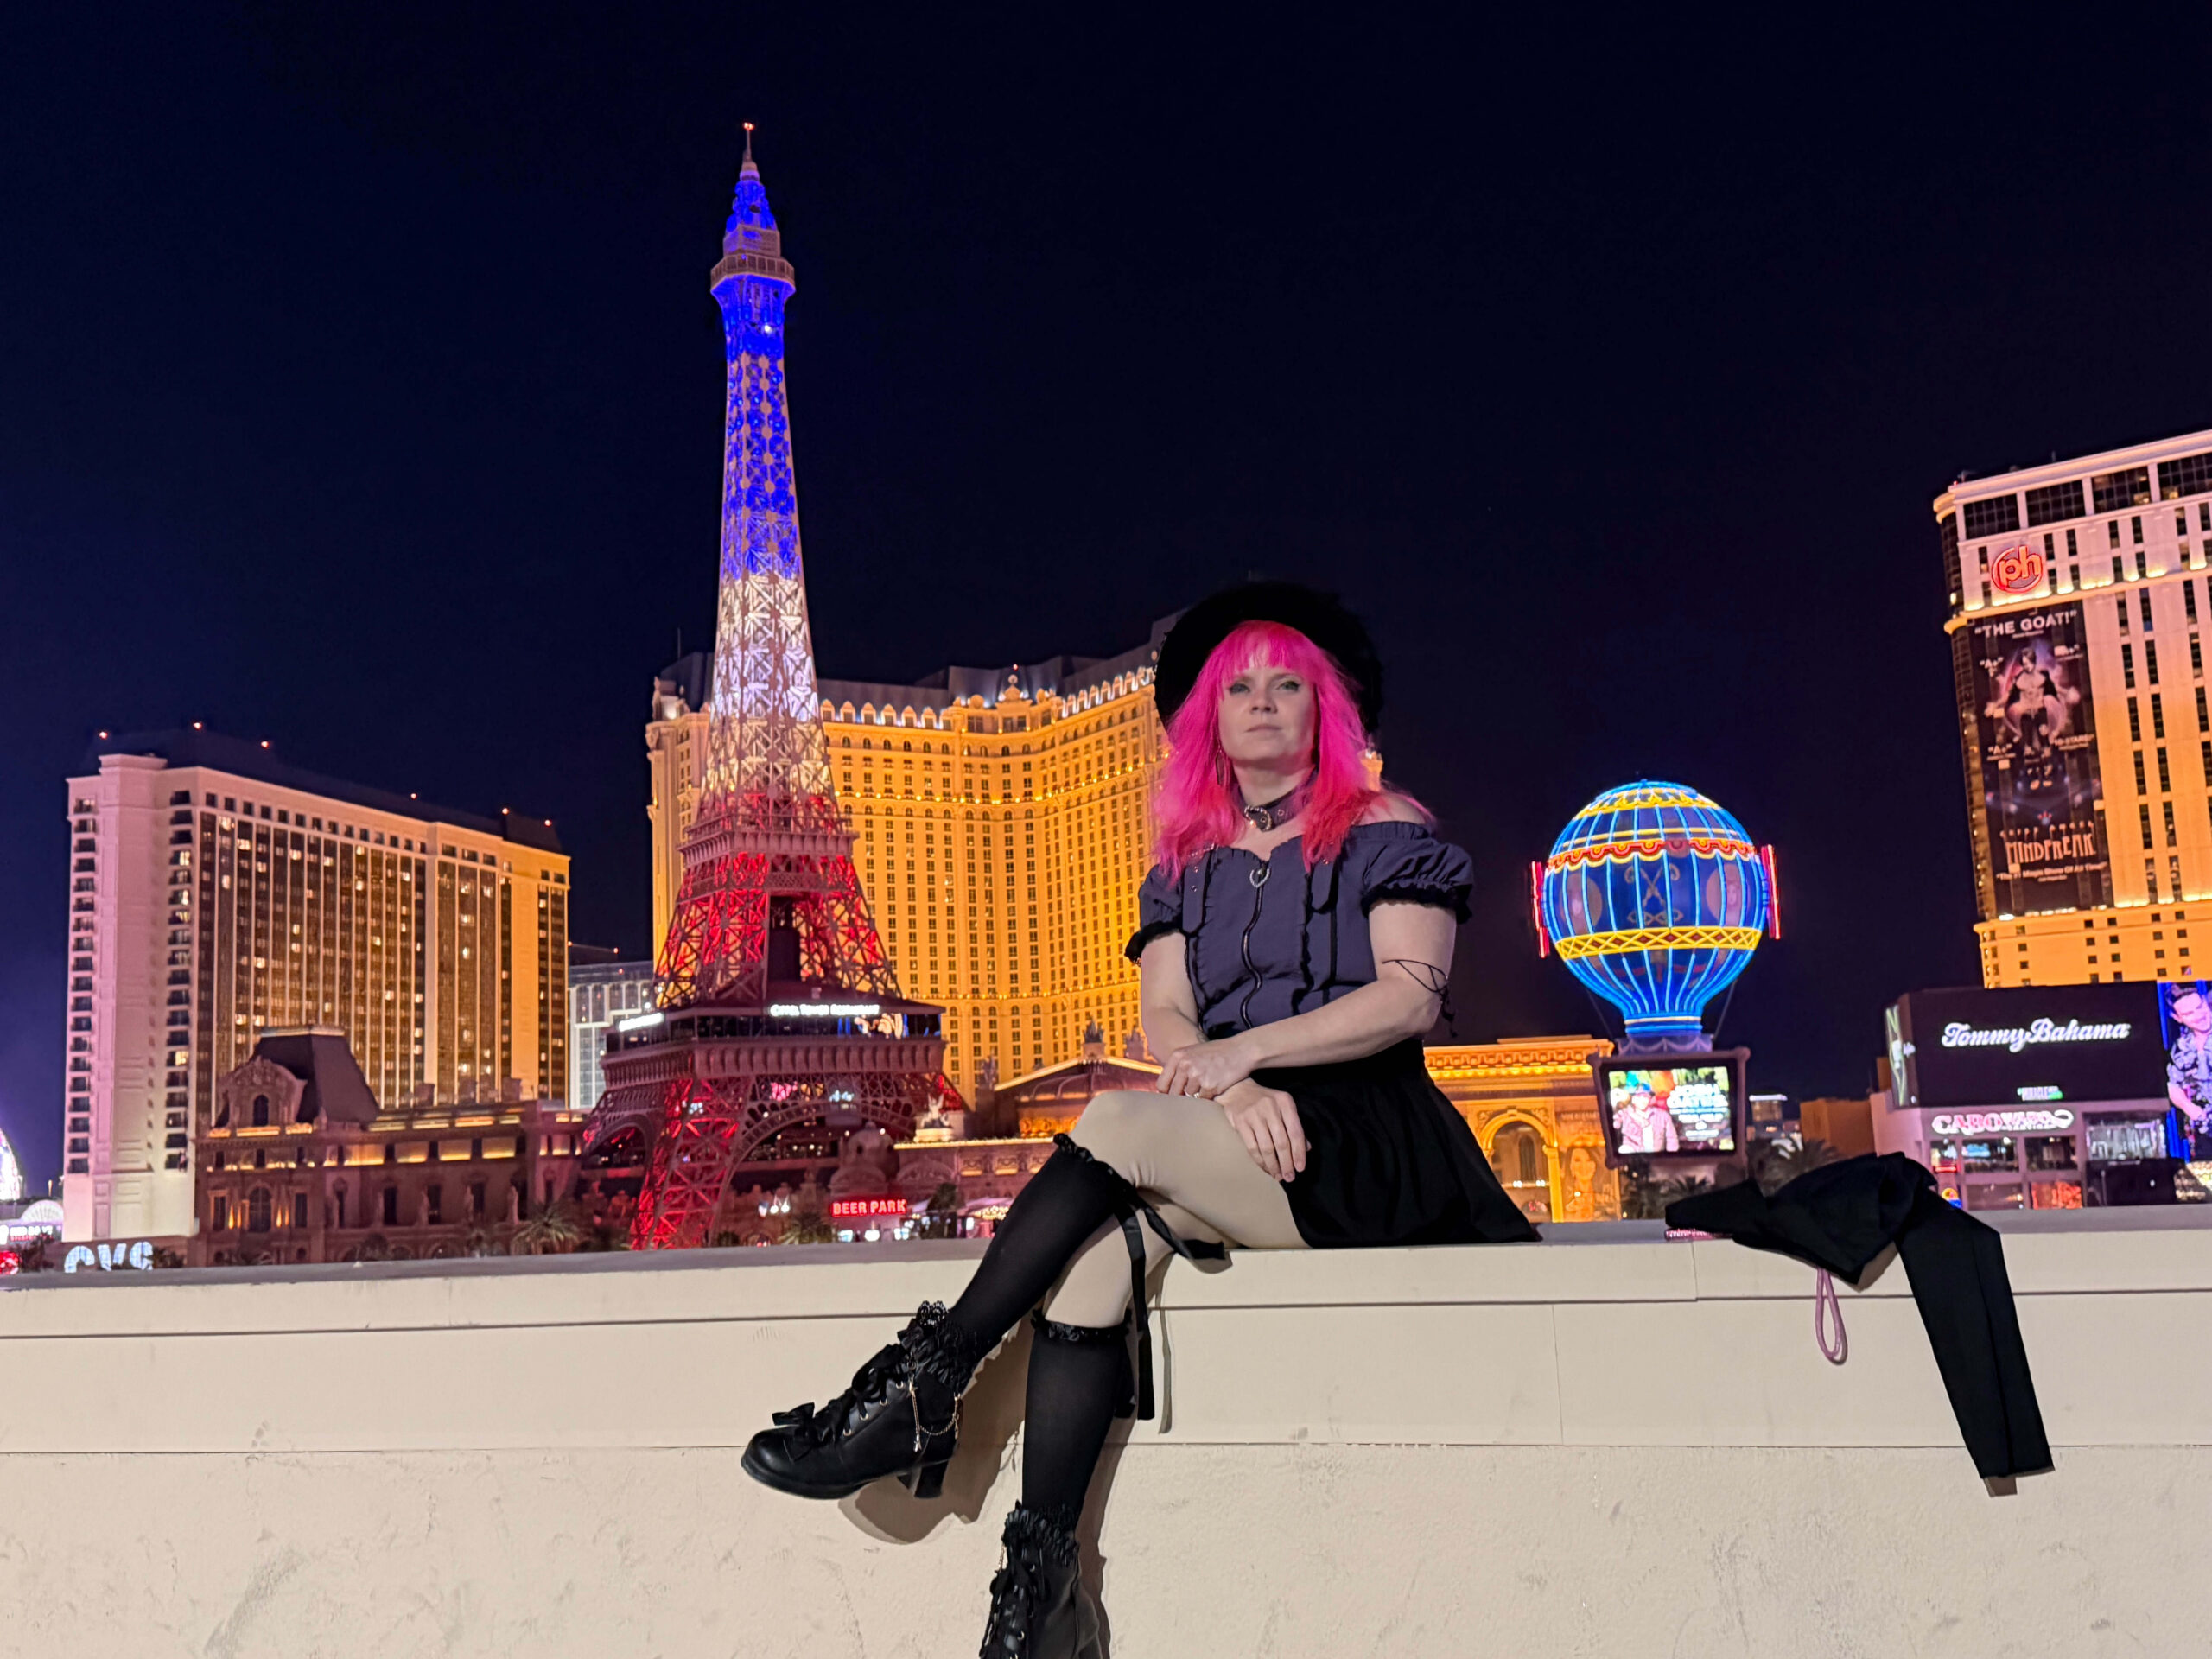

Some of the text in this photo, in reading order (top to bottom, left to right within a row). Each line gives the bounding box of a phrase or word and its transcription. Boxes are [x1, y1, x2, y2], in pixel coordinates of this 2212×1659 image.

[2020, 609, 2077, 632] GOAT!"
[2005, 833, 2096, 864] MINDFREAK
[1942, 1017, 2131, 1052] Tommy Bahama
[1932, 1112, 2004, 1135] CABO
[870, 1199, 906, 1214] PARK
